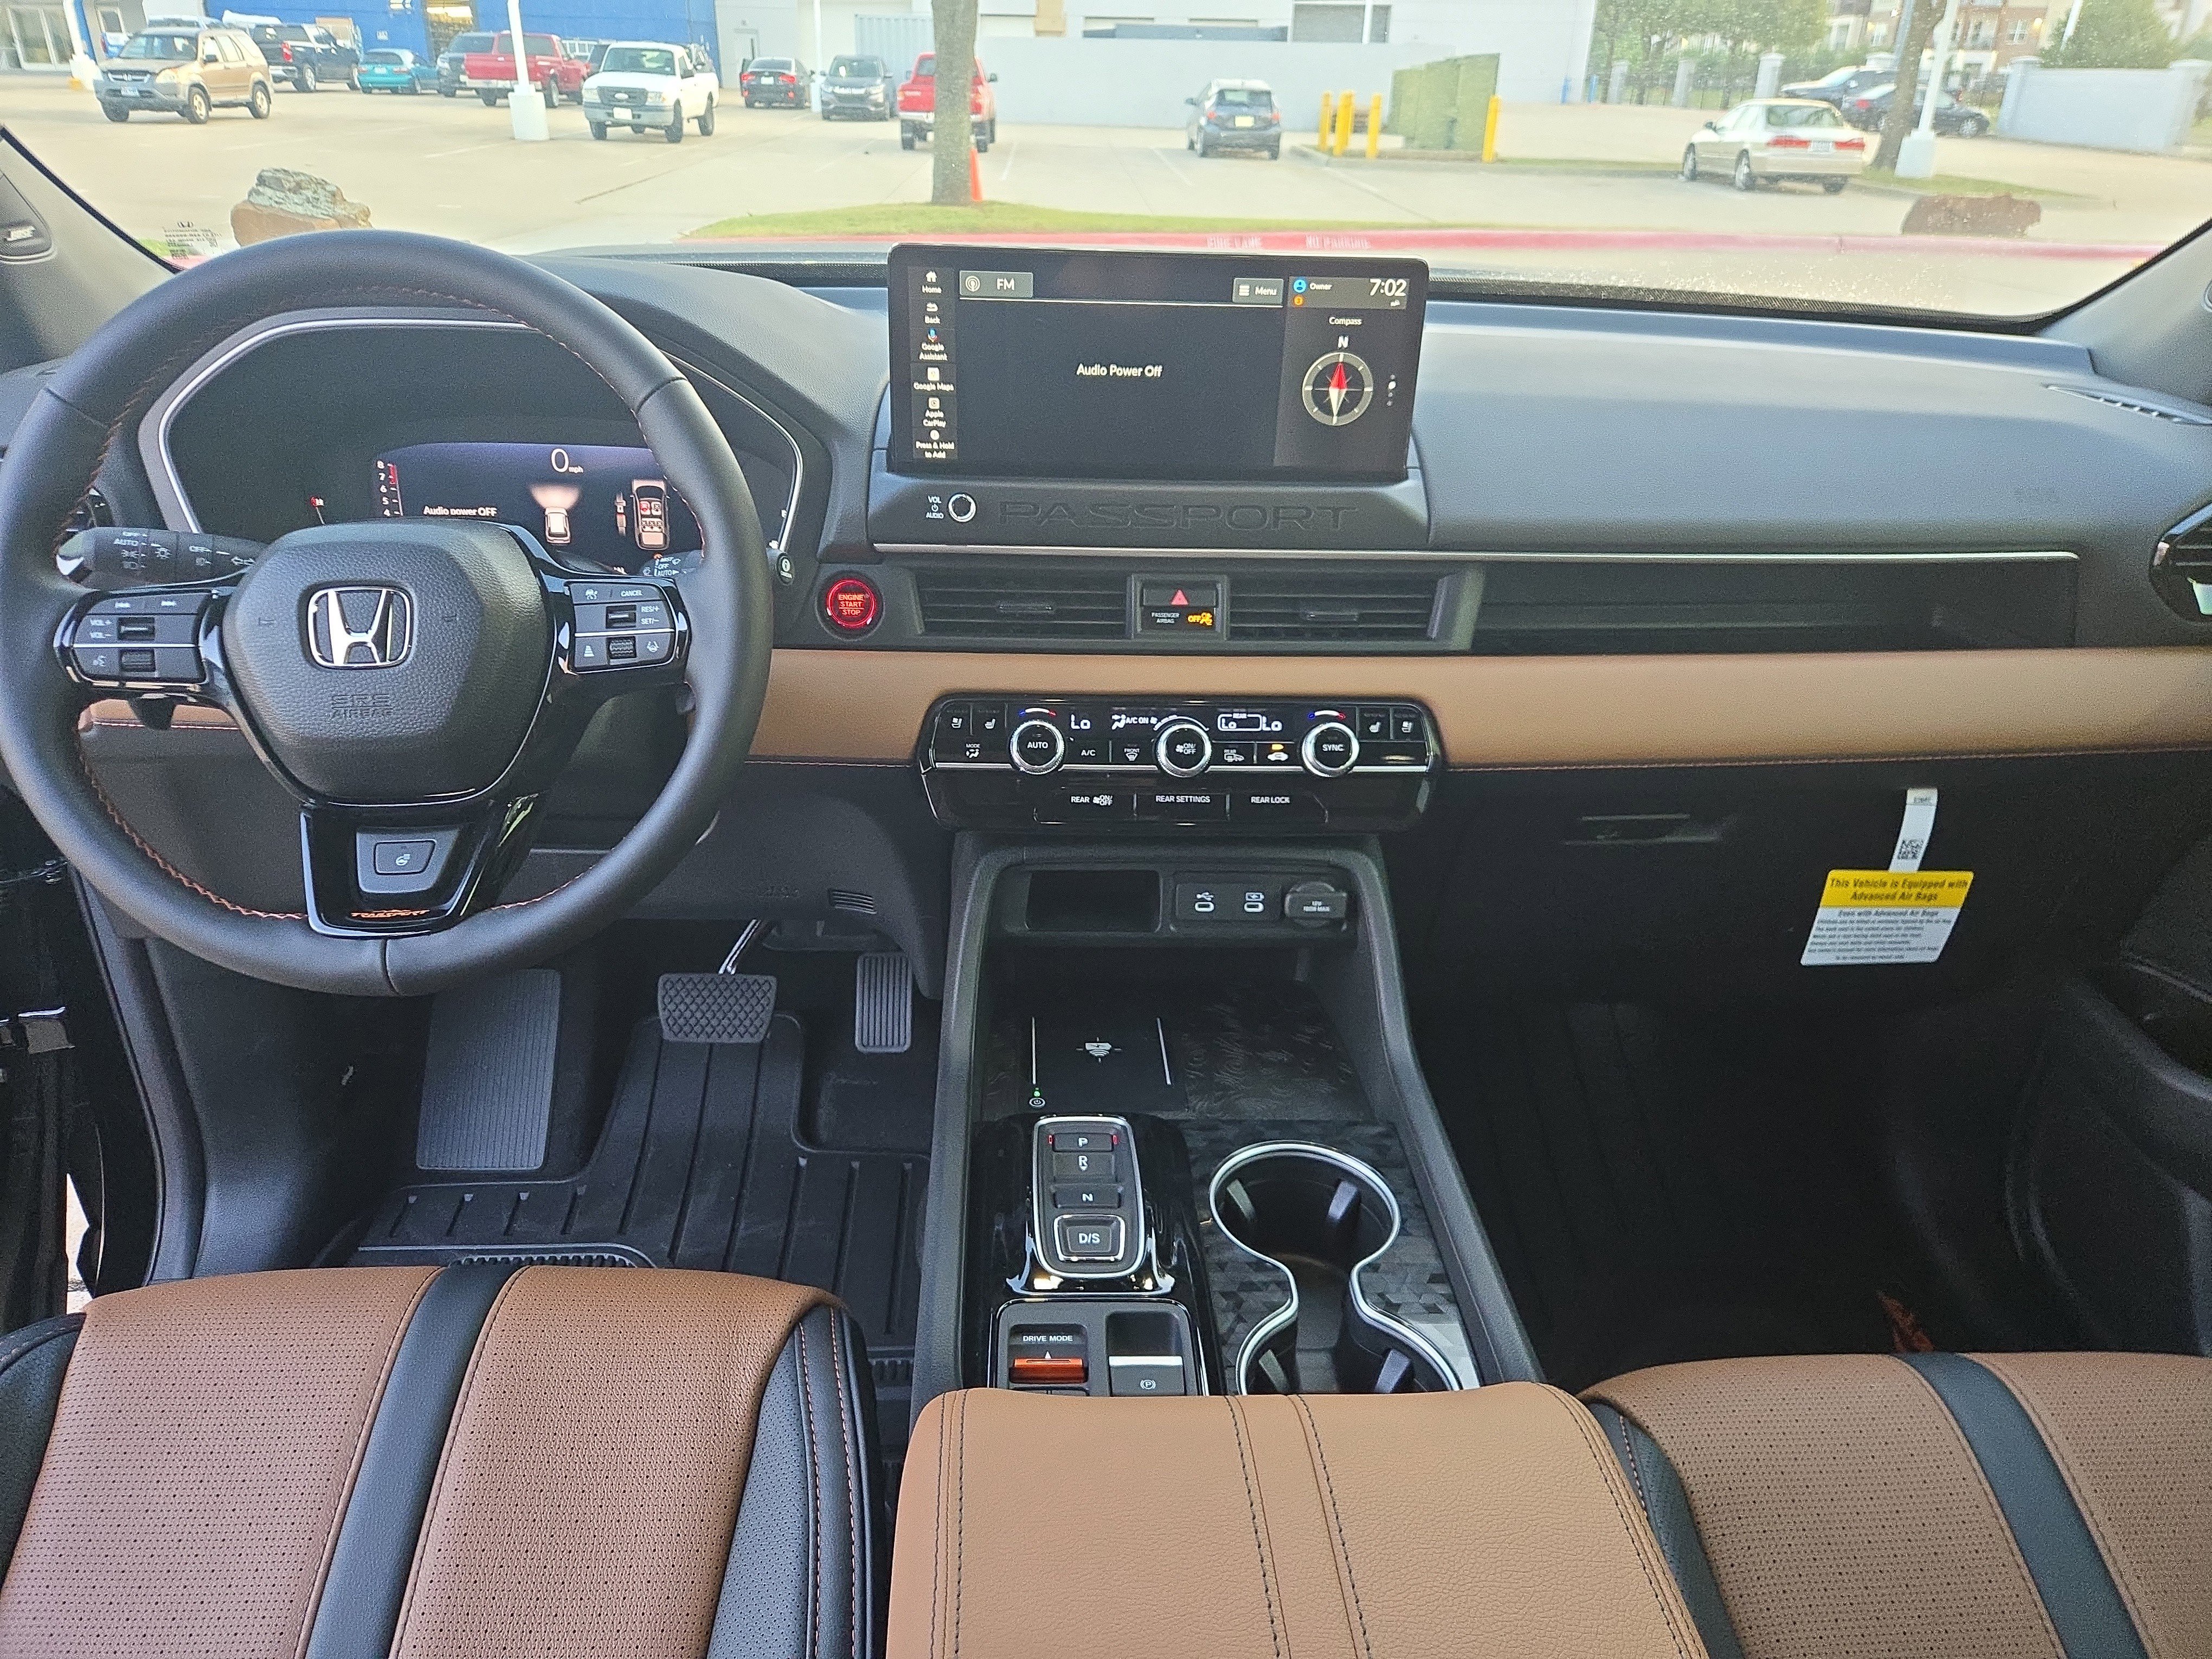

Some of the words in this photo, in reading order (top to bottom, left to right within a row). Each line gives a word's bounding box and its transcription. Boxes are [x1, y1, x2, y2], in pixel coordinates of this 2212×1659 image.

[996, 278, 1015, 291] FM
[1309, 282, 1332, 291] Owner
[1369, 278, 1407, 297] 7:02
[922, 285, 942, 294] Home
[1254, 286, 1277, 296] Menu
[924, 315, 941, 324] Back
[1328, 316, 1362, 326] Compass
[1338, 335, 1349, 348] N
[921, 343, 945, 352] Google
[918, 352, 948, 361] Assistant
[1076, 363, 1108, 376] Audio
[1109, 364, 1143, 377] Power
[1144, 365, 1163, 377] Off
[913, 382, 936, 391] Google
[936, 383, 955, 391] Maps
[925, 409, 944, 419] Apple
[922, 419, 947, 428] CarPlay
[915, 441, 932, 449] Press
[939, 441, 955, 449] Hold
[933, 451, 946, 459] Add
[377, 460, 385, 469] 8
[550, 448, 569, 473] 0
[568, 465, 584, 474] mph
[378, 472, 386, 481] 7
[380, 485, 387, 493] 6
[382, 497, 389, 505] 5
[927, 496, 942, 504] VOL
[383, 509, 390, 517] 4
[423, 505, 449, 516] Audio
[478, 507, 497, 517] OFF
[999, 501, 1359, 532] PASSPORT
[1187, 615, 1201, 623] OFF
[1126, 716, 1137, 724] A/C
[1027, 741, 1049, 749] AUTO
[1175, 795, 1211, 803] SETTINGS
[1830, 878, 1849, 888] This
[1853, 878, 1888, 888] Vehicle
[1901, 878, 1946, 889] Equipped
[1850, 891, 1897, 901] Advanced
[1914, 892, 1938, 902] Bags
[1078, 1137, 1089, 1147] P
[1078, 1155, 1088, 1166] R
[1082, 1193, 1094, 1202] N
[1078, 1233, 1101, 1244] D/S
